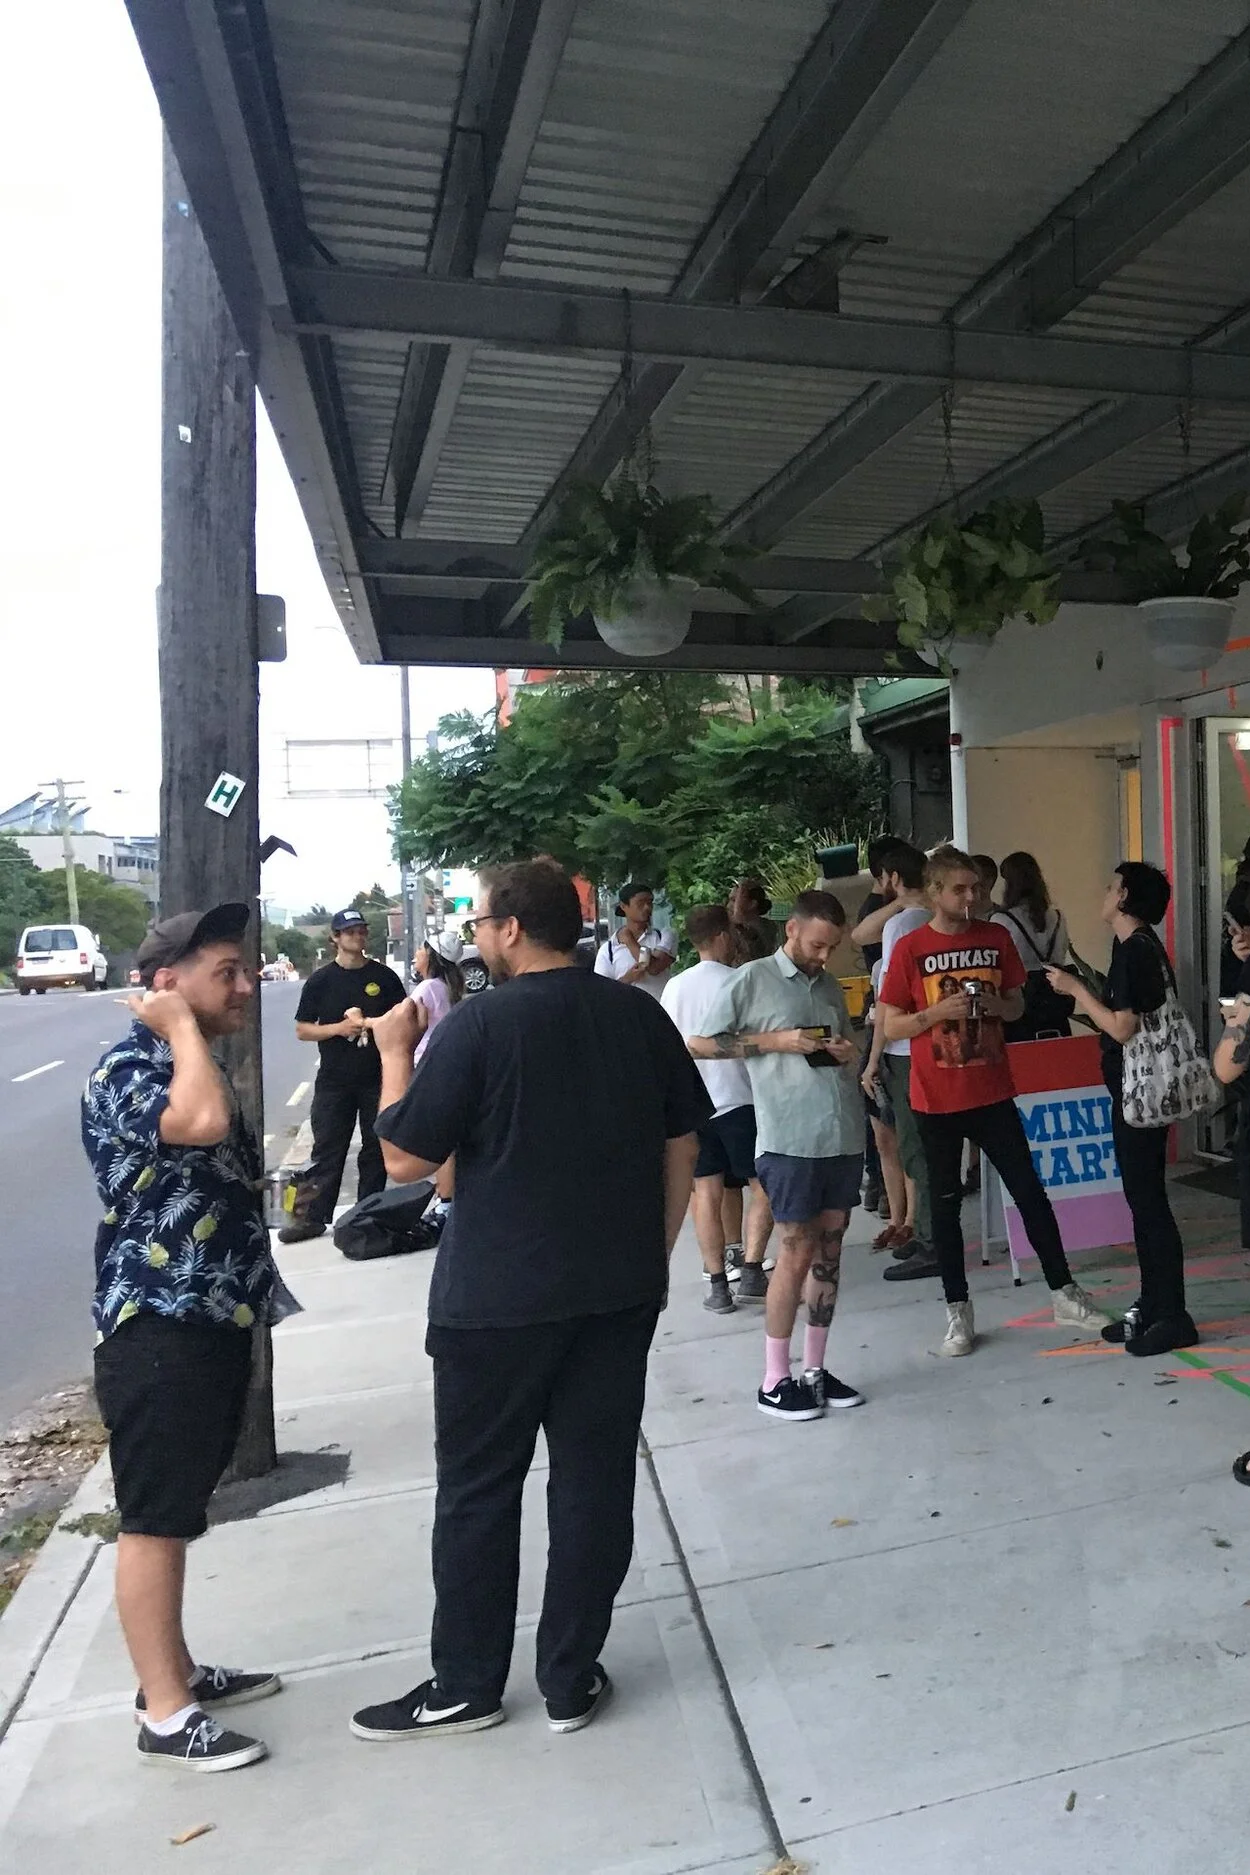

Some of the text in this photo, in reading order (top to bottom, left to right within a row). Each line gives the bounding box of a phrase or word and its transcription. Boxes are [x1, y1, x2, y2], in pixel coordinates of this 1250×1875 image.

[212, 780, 239, 808] H
[924, 949, 999, 973] OUTKAST
[1017, 1096, 1113, 1142] MINI
